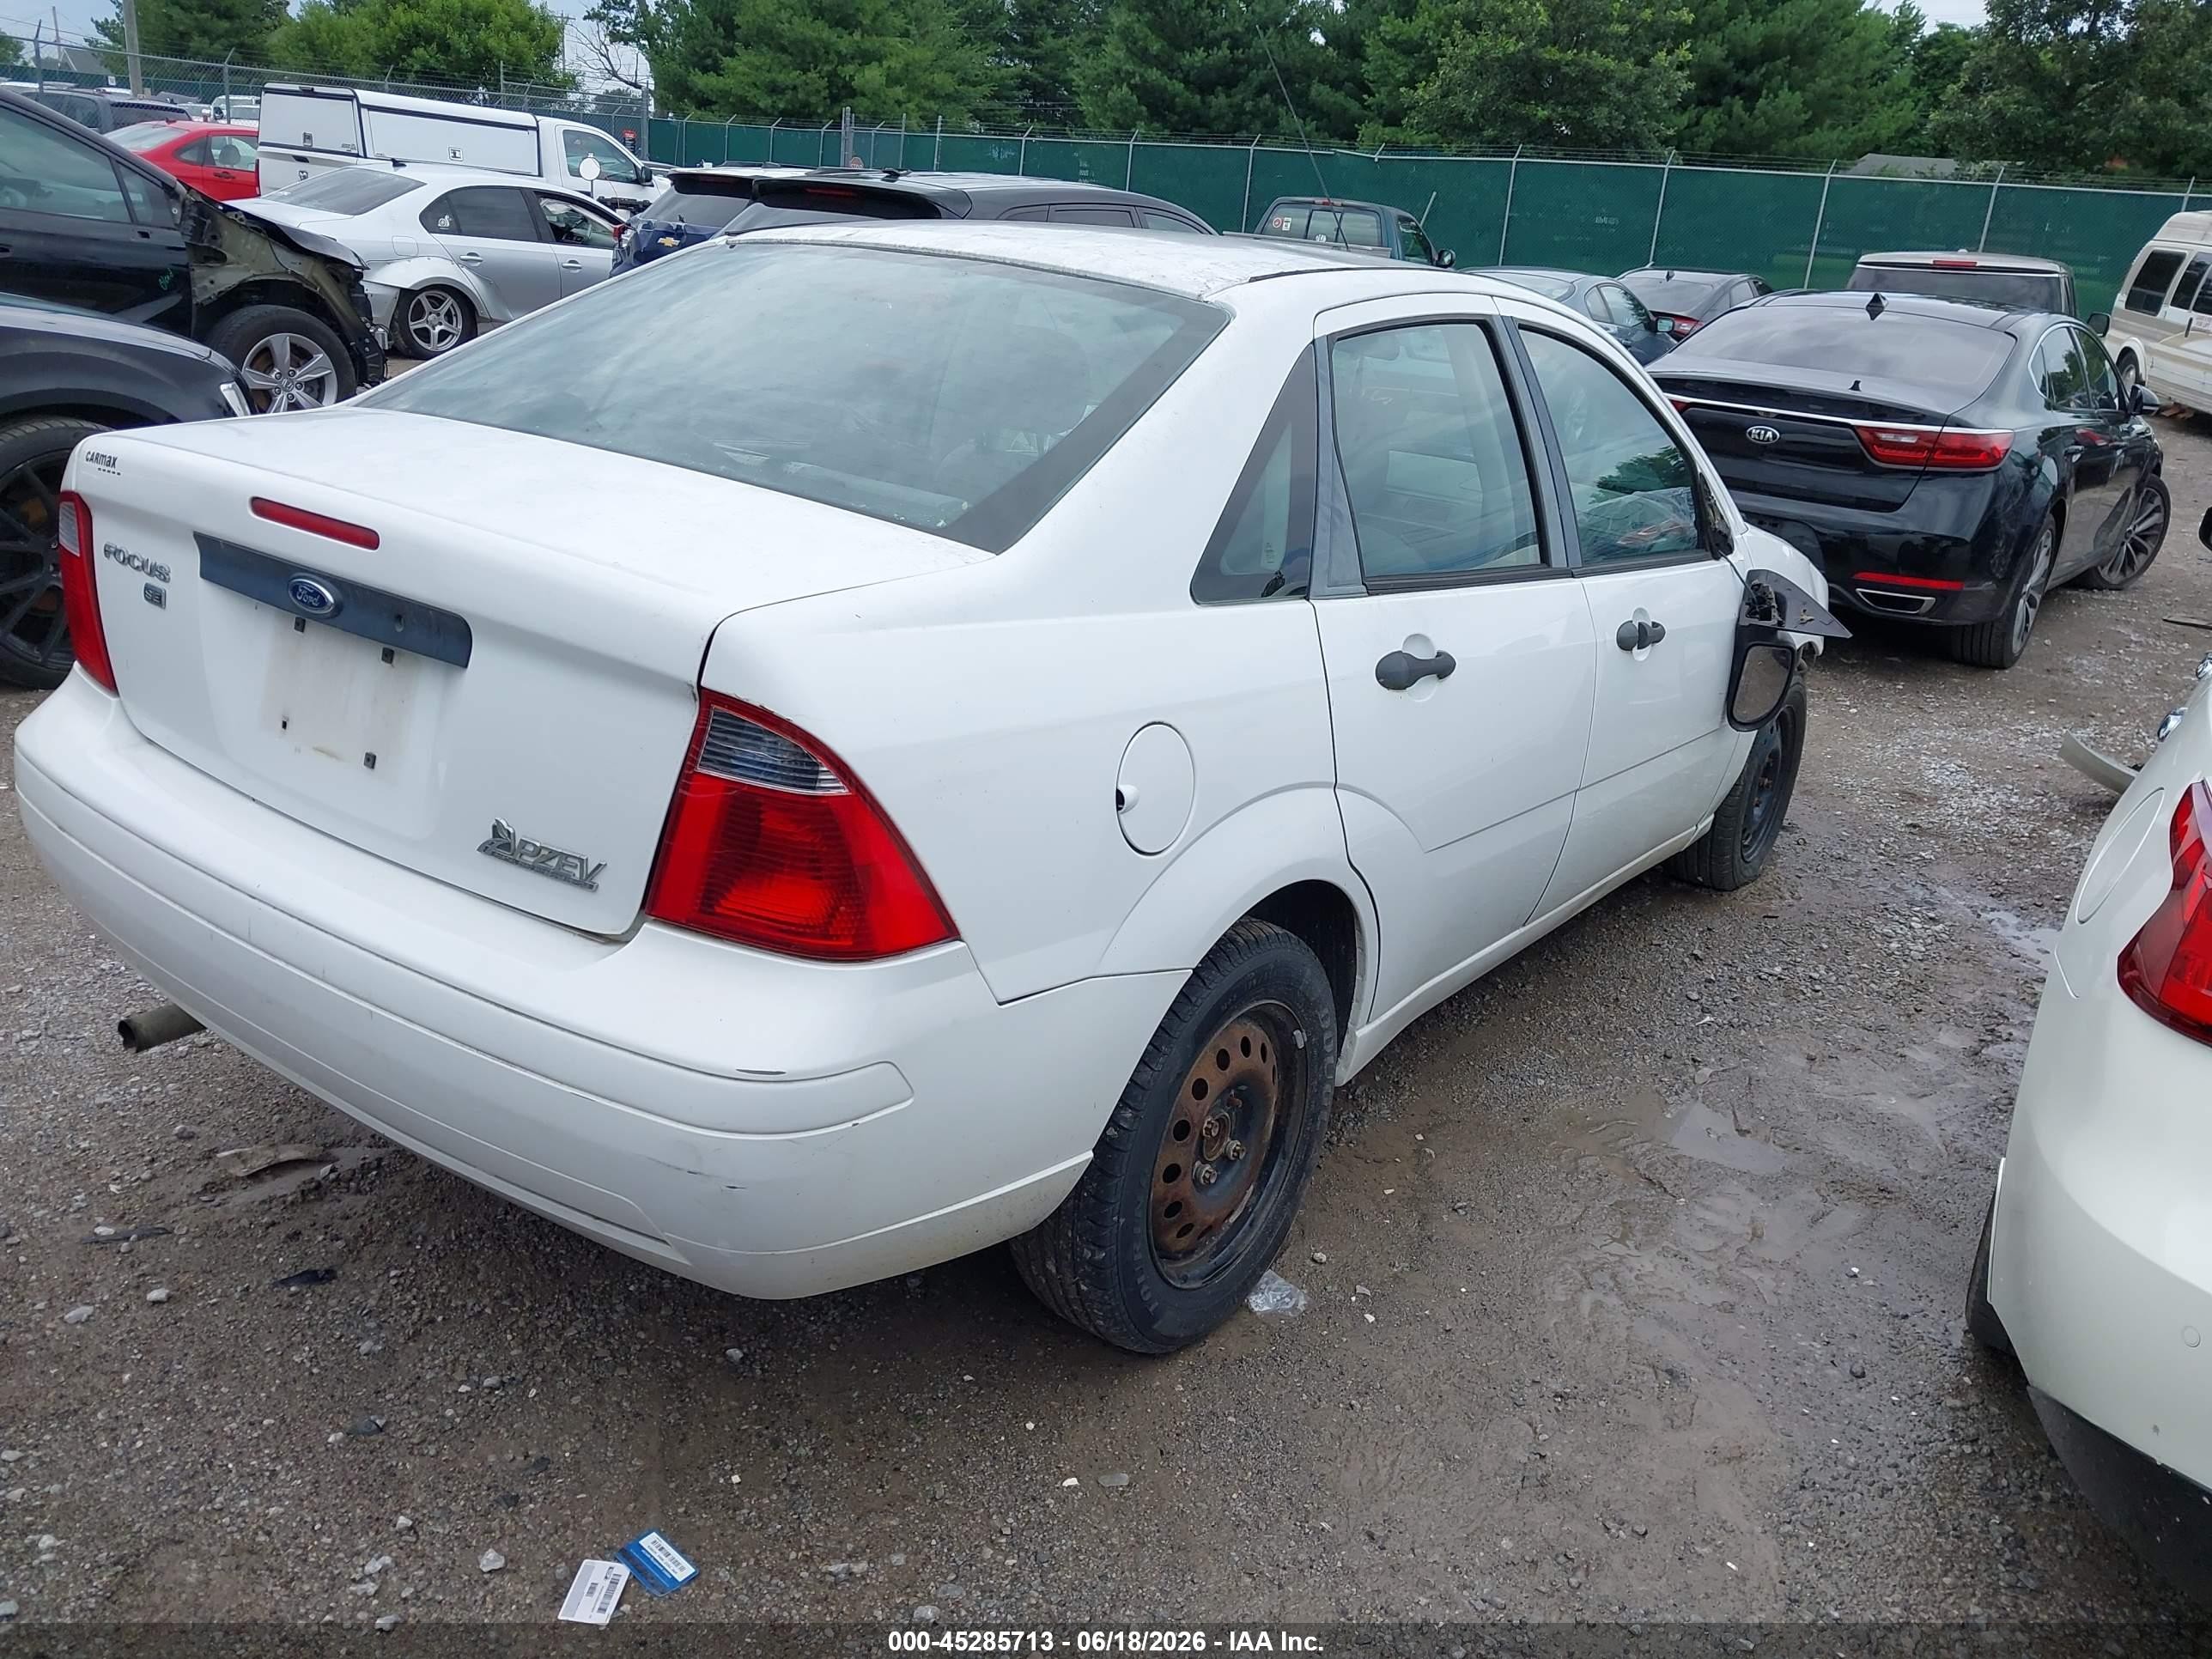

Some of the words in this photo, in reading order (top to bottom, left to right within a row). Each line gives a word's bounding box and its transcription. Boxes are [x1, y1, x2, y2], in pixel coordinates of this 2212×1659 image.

[1751, 428, 1773, 441] KIA
[103, 542, 171, 583] FOCUS
[143, 586, 165, 606] SE
[296, 584, 321, 606] Ford
[516, 837, 607, 883] PZEV
